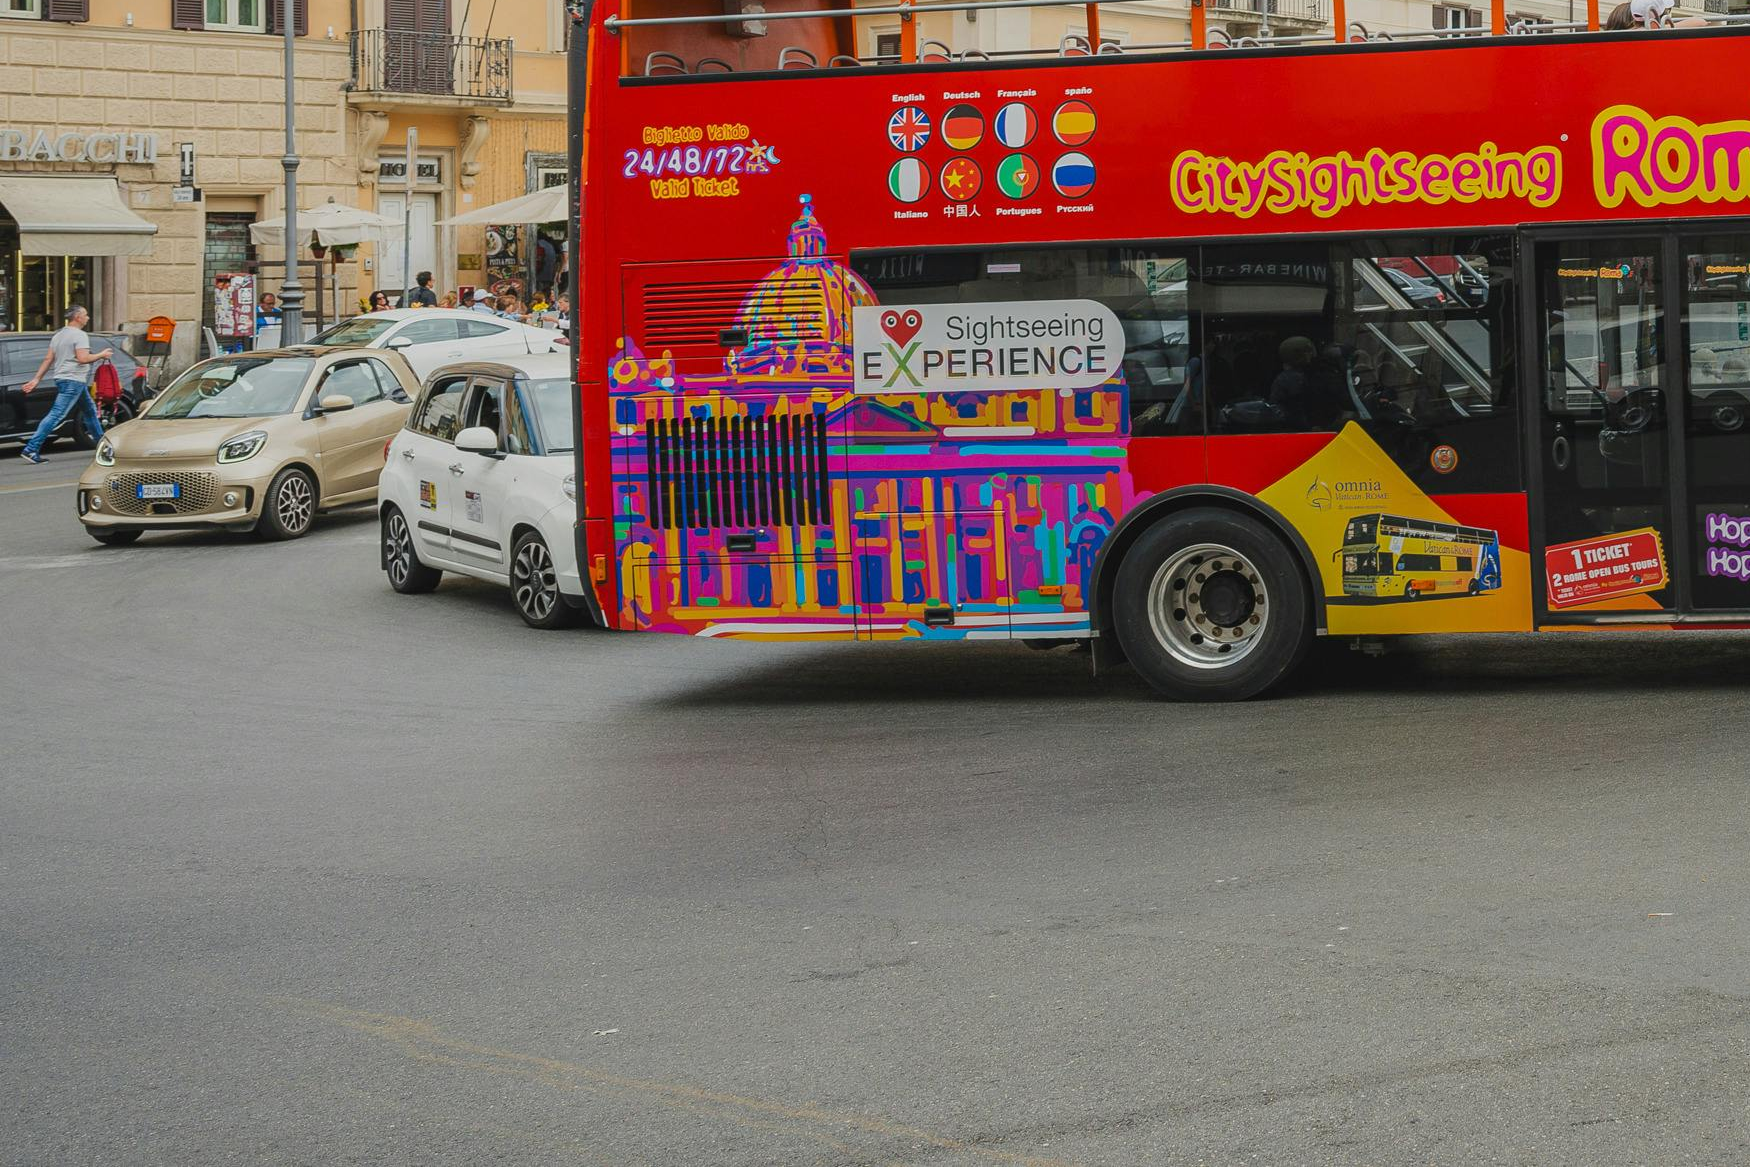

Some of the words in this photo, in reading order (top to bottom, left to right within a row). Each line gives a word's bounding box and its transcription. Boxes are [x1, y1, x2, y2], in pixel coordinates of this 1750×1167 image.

[892, 94, 925, 103] English
[943, 91, 980, 100] Deutsch
[997, 89, 1037, 98] Français
[643, 127, 702, 146] Biglietto
[707, 124, 749, 141] Valido
[624, 145, 745, 176] 24/48/72
[380, 163, 438, 177] HOEL
[651, 179, 690, 199] Valid
[693, 177, 740, 196] Ticket
[894, 211, 928, 219] Italiano
[943, 204, 981, 218] 中国人
[996, 207, 1042, 216] Portugues
[946, 313, 1104, 346] Sightseeing
[863, 342, 1107, 388] EXPERIENCE
[1335, 479, 1381, 492] omnia
[1571, 549, 1583, 570] 1
[1584, 543, 1630, 564] TICKET
[1552, 572, 1563, 587] 2
[1563, 571, 1588, 583] ROME
[1588, 568, 1612, 579] OPEN
[1613, 564, 1630, 575] BUS
[1631, 558, 1659, 571] TOURS
